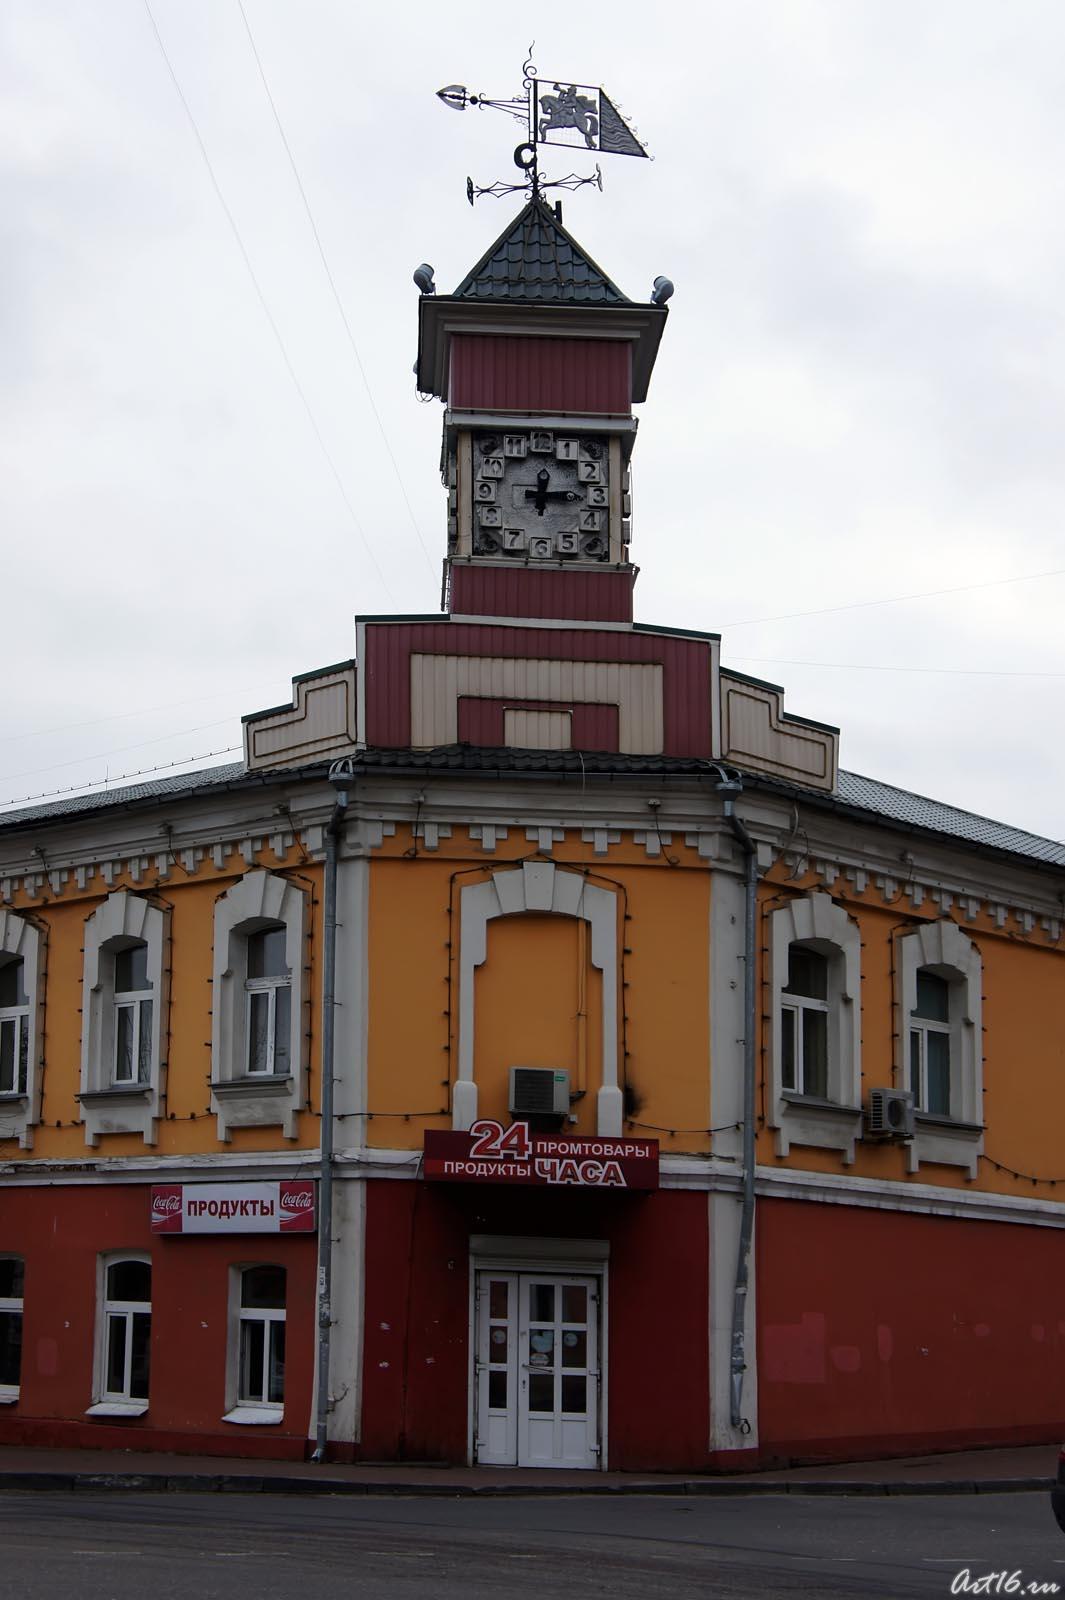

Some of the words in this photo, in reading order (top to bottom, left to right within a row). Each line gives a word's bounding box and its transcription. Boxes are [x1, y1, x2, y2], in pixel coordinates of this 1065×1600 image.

[507, 438, 522, 455] 11
[563, 442, 570, 458] 1
[584, 463, 596, 480] 2
[478, 483, 492, 499] 9
[593, 488, 605, 504] 3
[583, 512, 597, 528] 4
[508, 531, 520, 547] 7
[562, 535, 574, 550] 5
[535, 540, 548, 555] 6
[469, 1120, 532, 1160] 24
[536, 1141, 649, 1158] ПРОМТОВАРЫ
[444, 1161, 531, 1177] ПРОДУКТЫ
[534, 1158, 627, 1187] ЧАСА
[187, 1200, 275, 1219] ПРОДУКТЫ
